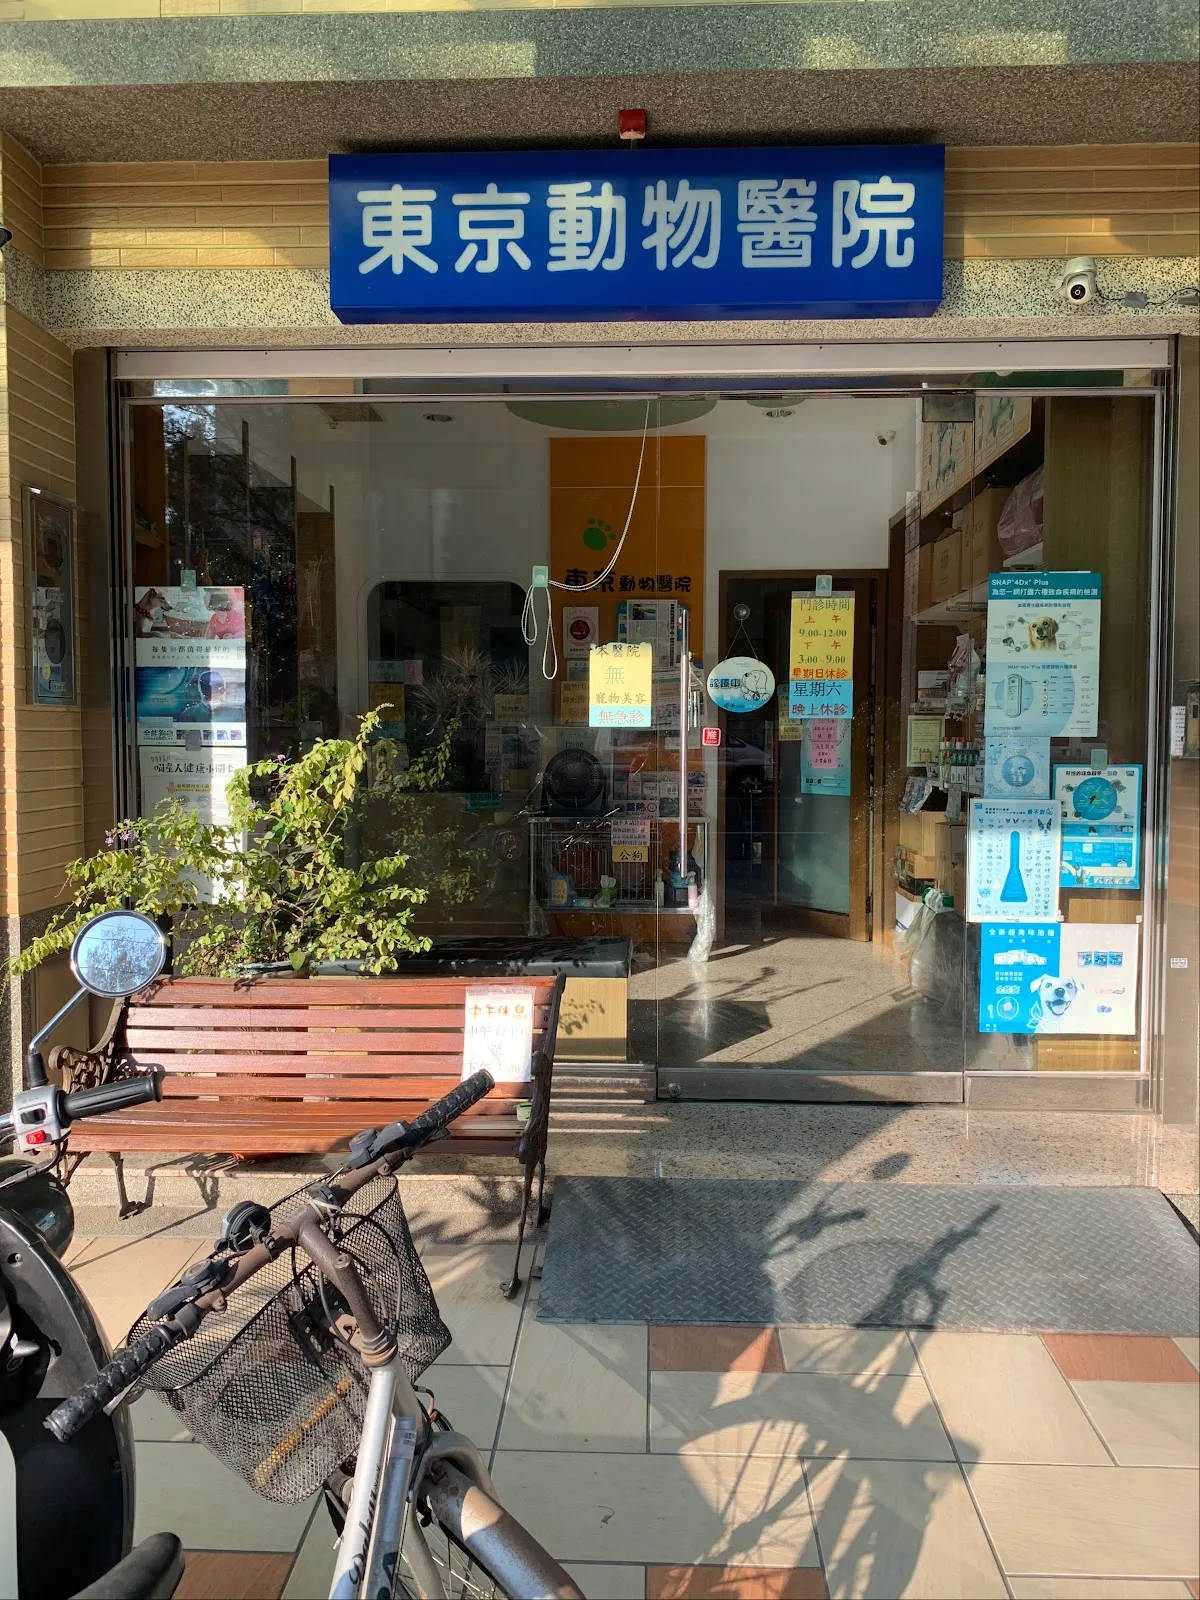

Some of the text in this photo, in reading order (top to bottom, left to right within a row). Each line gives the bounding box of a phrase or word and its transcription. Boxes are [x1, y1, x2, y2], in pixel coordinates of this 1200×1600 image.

[356, 175, 916, 276] 東京動物醫院
[800, 598, 850, 611] 門診時間
[596, 645, 641, 658] 本醫院
[605, 665, 625, 685] 無
[792, 668, 849, 679] 星期日休診
[793, 681, 842, 697] 星期六
[595, 693, 647, 704] 寵物美容
[791, 703, 848, 716] 晚上休診
[599, 710, 645, 725] 無急診
[706, 729, 717, 739] 推
[619, 850, 643, 861] 公狗
